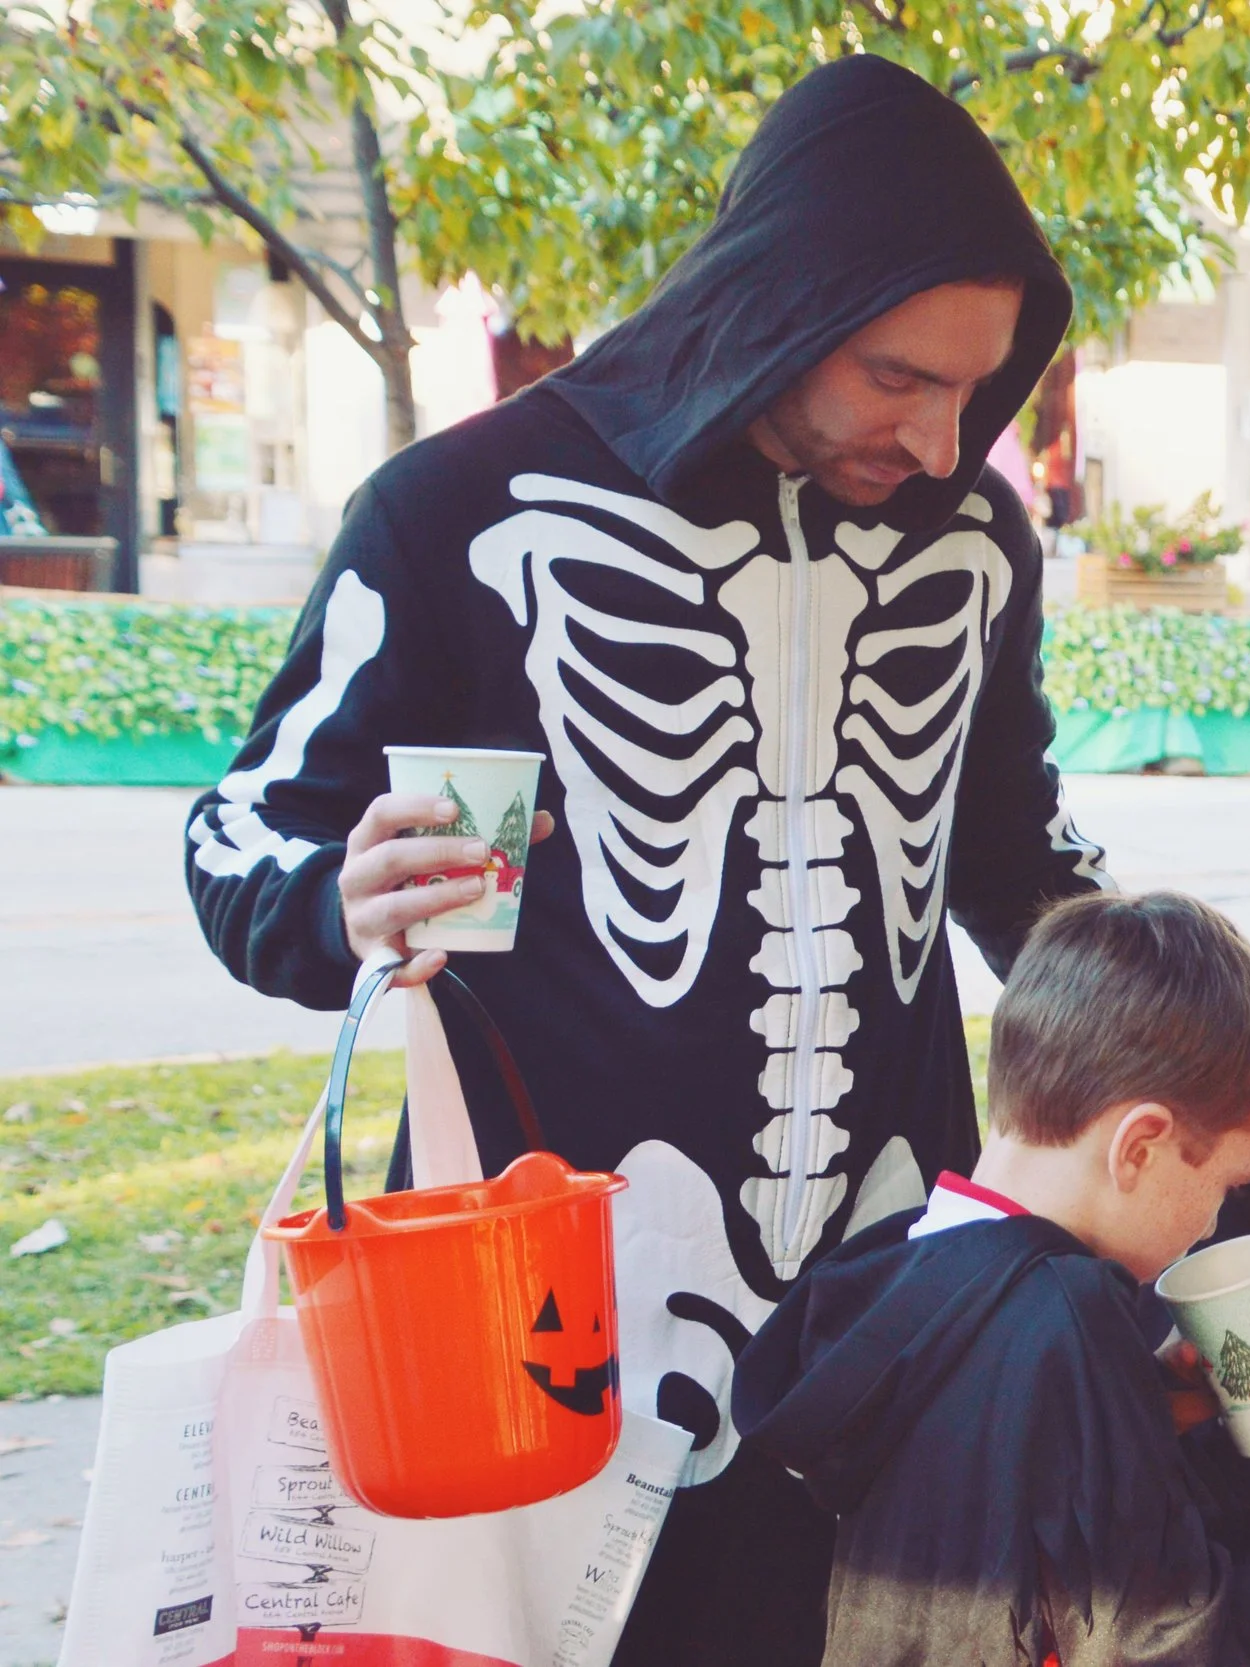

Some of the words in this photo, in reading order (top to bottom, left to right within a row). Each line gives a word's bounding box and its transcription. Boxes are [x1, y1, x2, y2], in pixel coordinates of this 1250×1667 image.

[260, 1525, 308, 1546] Wild
[315, 1533, 362, 1554] Willow
[245, 1591, 319, 1609] Central
[326, 1586, 359, 1608] Cafe
